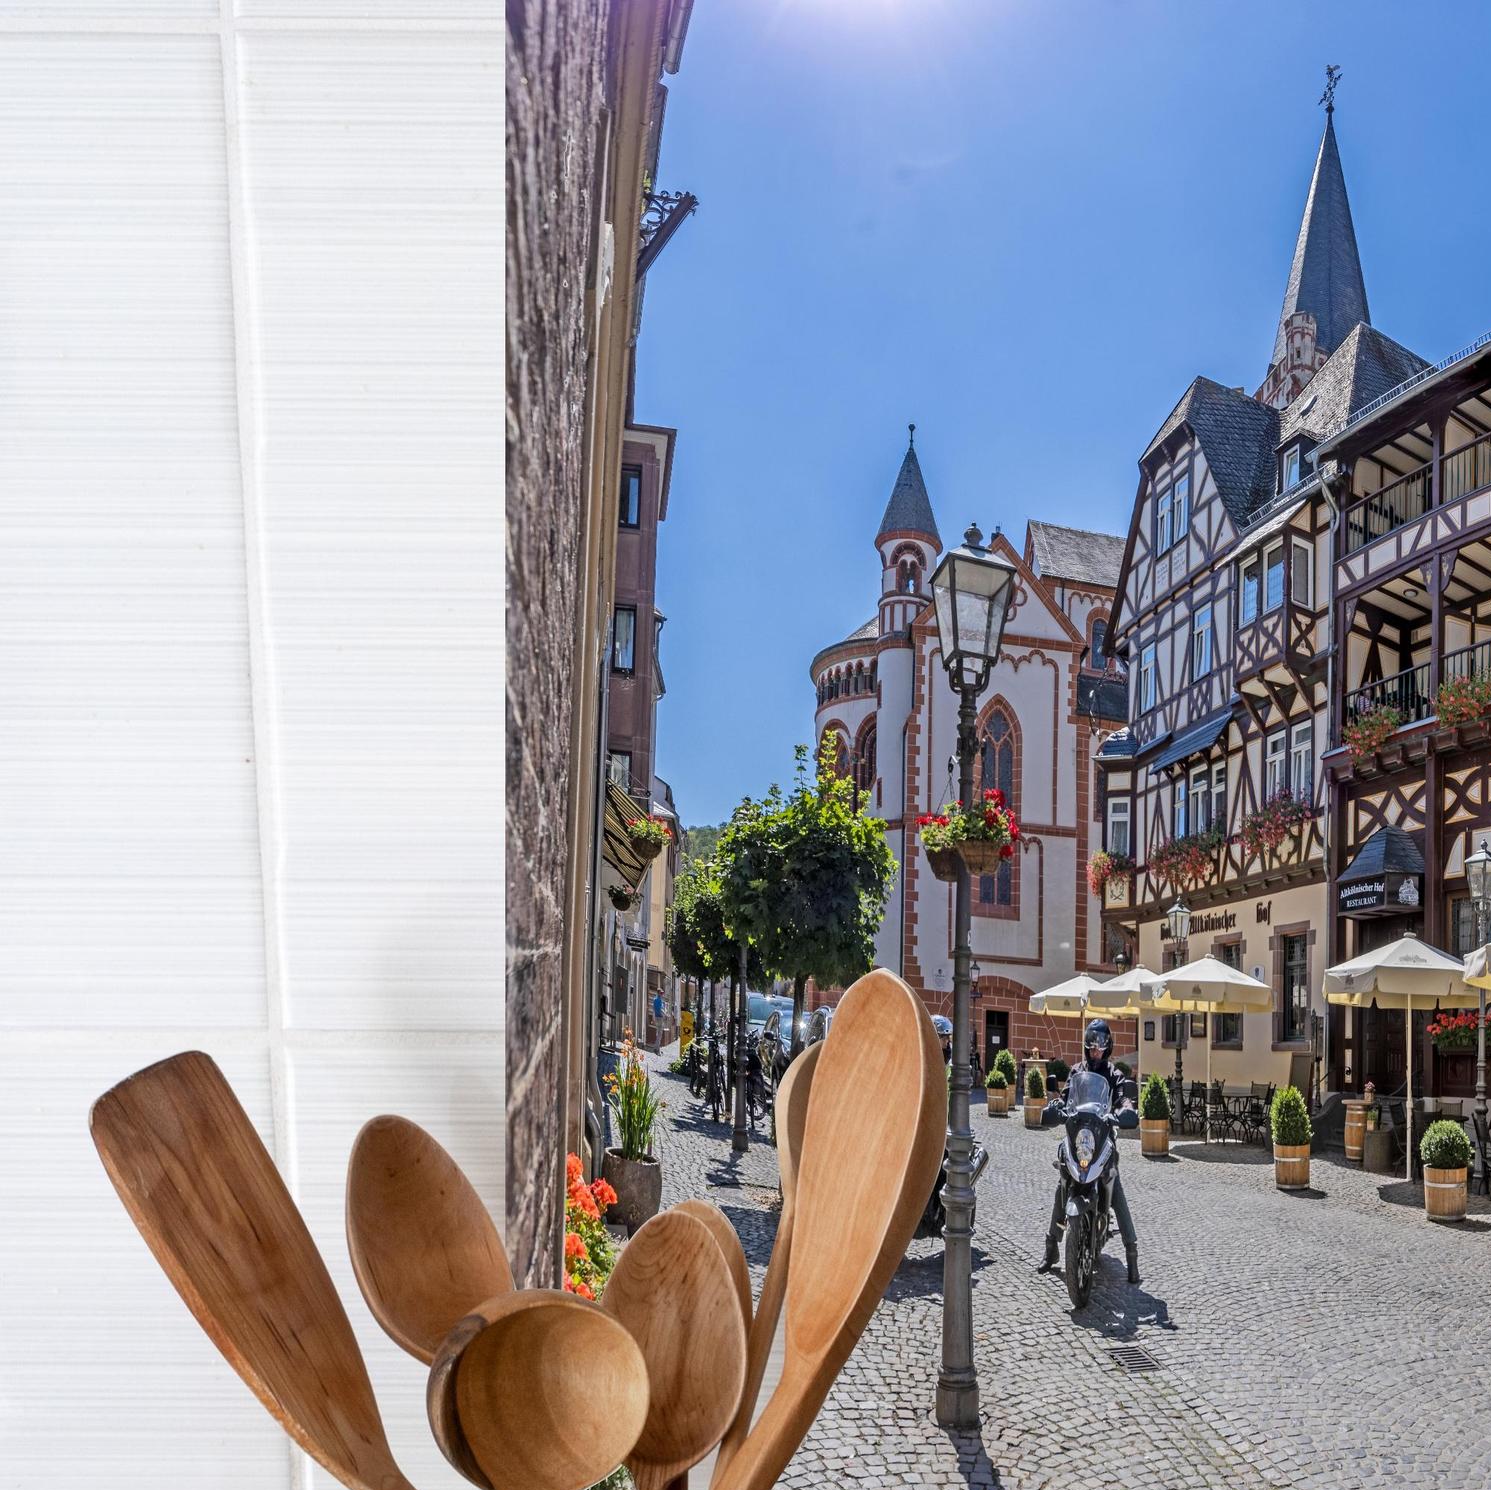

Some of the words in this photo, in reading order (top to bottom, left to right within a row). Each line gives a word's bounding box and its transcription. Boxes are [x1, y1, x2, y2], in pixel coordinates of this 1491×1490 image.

[1340, 883, 1373, 899] Altkölnischer
[1374, 882, 1384, 892] Hof
[1346, 896, 1377, 908] RESTAURANT
[1256, 900, 1272, 925] Hof
